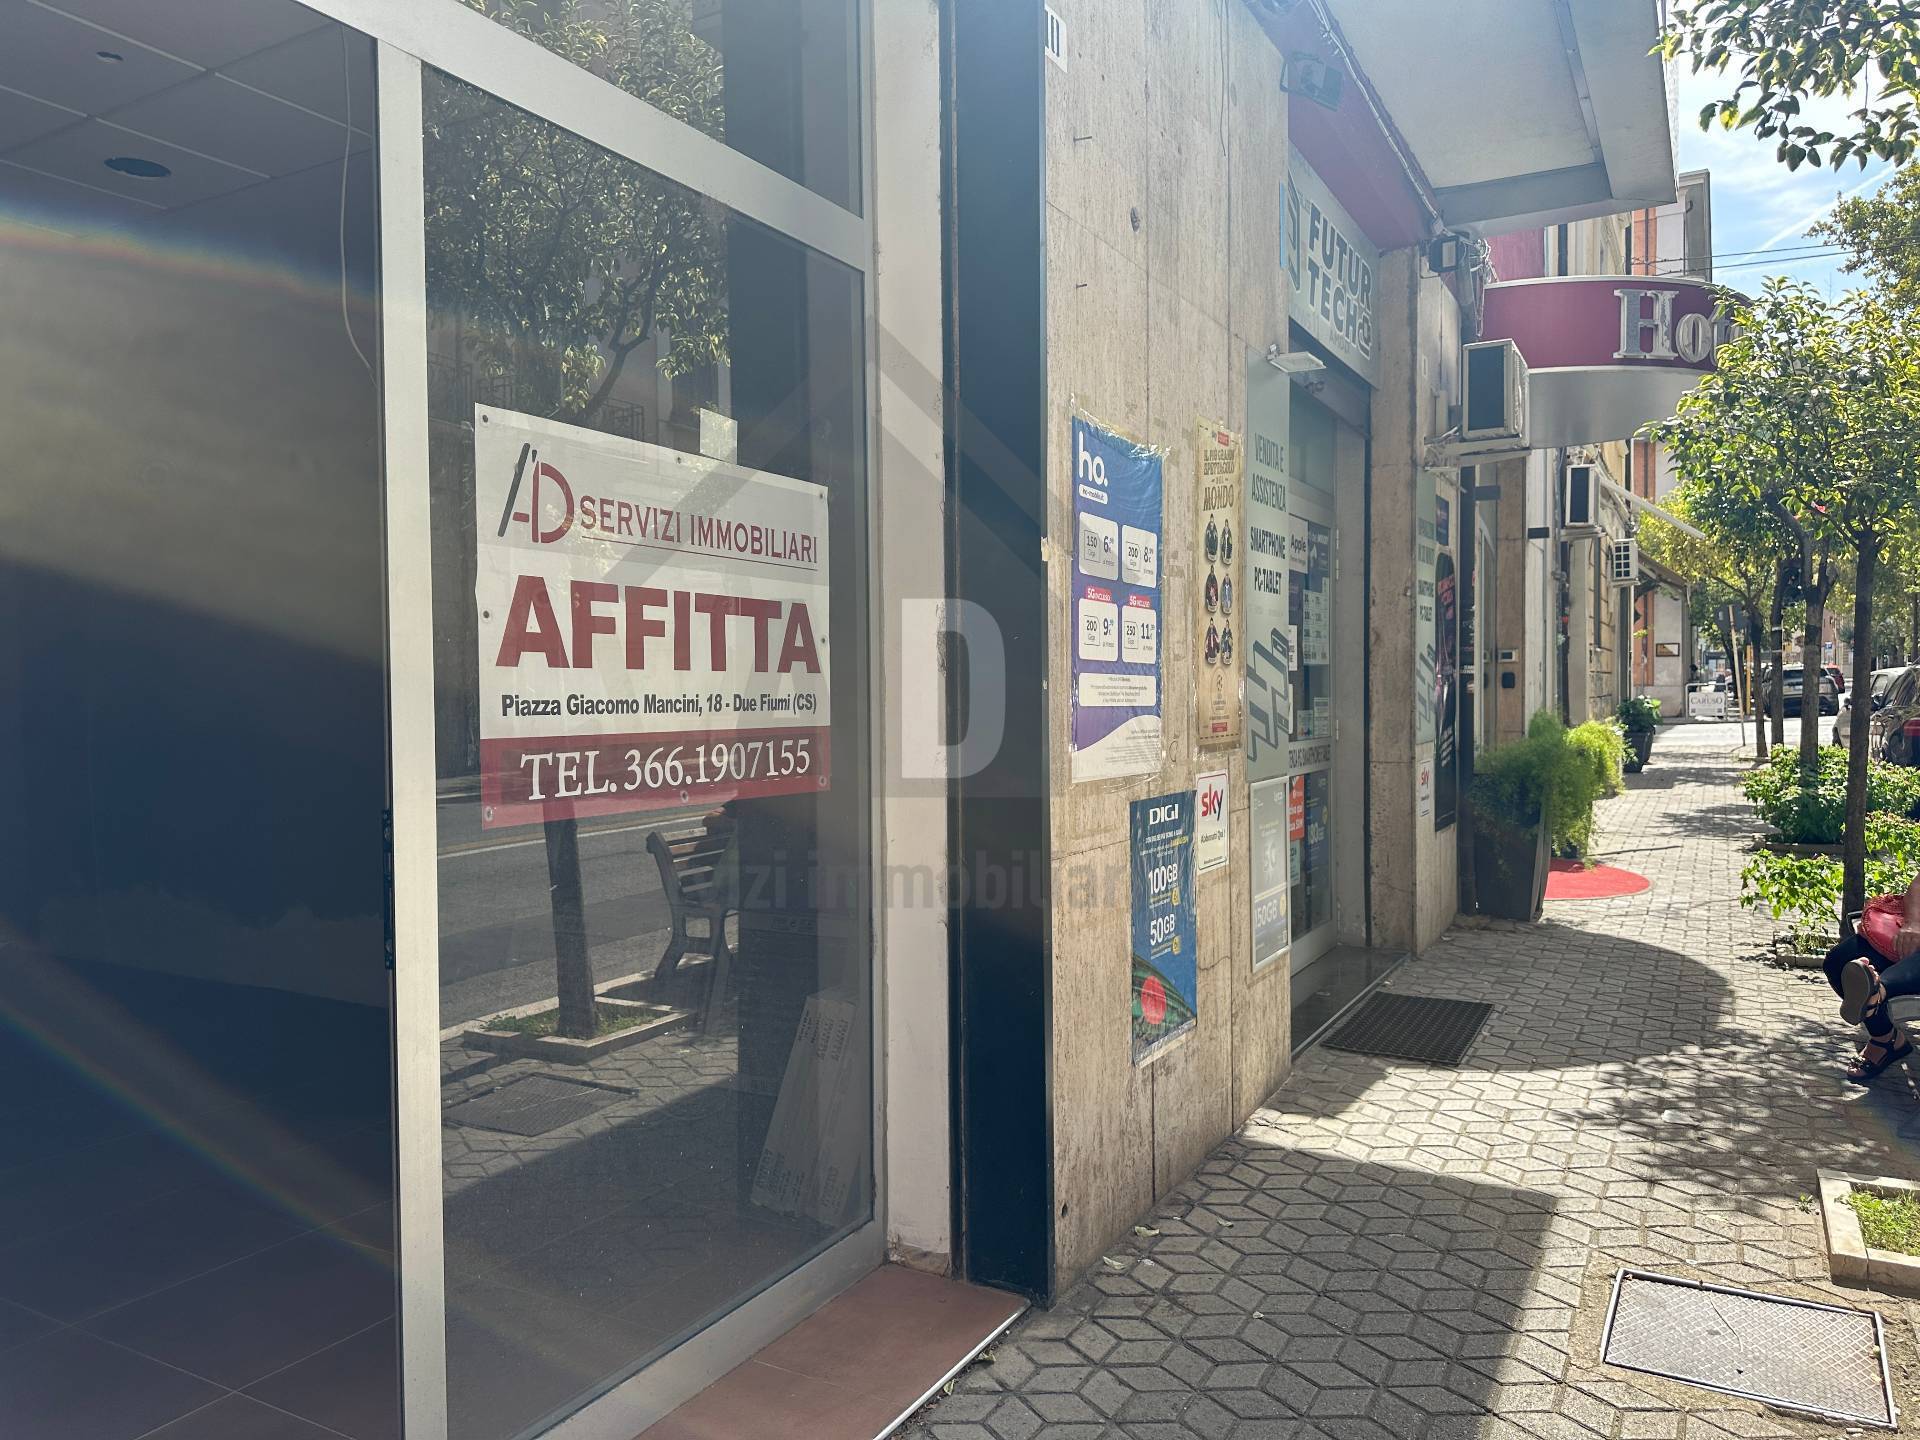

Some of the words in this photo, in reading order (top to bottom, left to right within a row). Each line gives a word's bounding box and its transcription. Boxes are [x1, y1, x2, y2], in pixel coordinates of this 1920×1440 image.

[1308, 200, 1372, 314] FUTUR
[1613, 289, 1740, 366] Hot
[1255, 432, 1279, 470] VENDITA
[1203, 484, 1235, 511] MONDO
[1251, 473, 1287, 512] ASSISTENZA
[580, 495, 682, 543] SERVIZI
[690, 514, 818, 564] IMMOBILIARI
[1086, 535, 1098, 548] 150
[1250, 526, 1286, 560] SMARTPHONE
[1087, 587, 1096, 600] 5G
[1129, 595, 1137, 607] 5G
[496, 574, 822, 674] AFFITTA
[1086, 620, 1098, 632] 200
[502, 694, 562, 716] Piazza
[566, 693, 640, 716] Giacomo
[644, 693, 703, 717] Mancini,
[706, 694, 722, 713] 18
[733, 693, 757, 712] Due
[760, 693, 790, 712] Fiumi
[793, 692, 817, 715] (CS)
[520, 750, 617, 801] TEL.
[624, 738, 812, 790] 366.1907155
[1149, 804, 1179, 825] DIGI
[1202, 784, 1224, 821] sky
